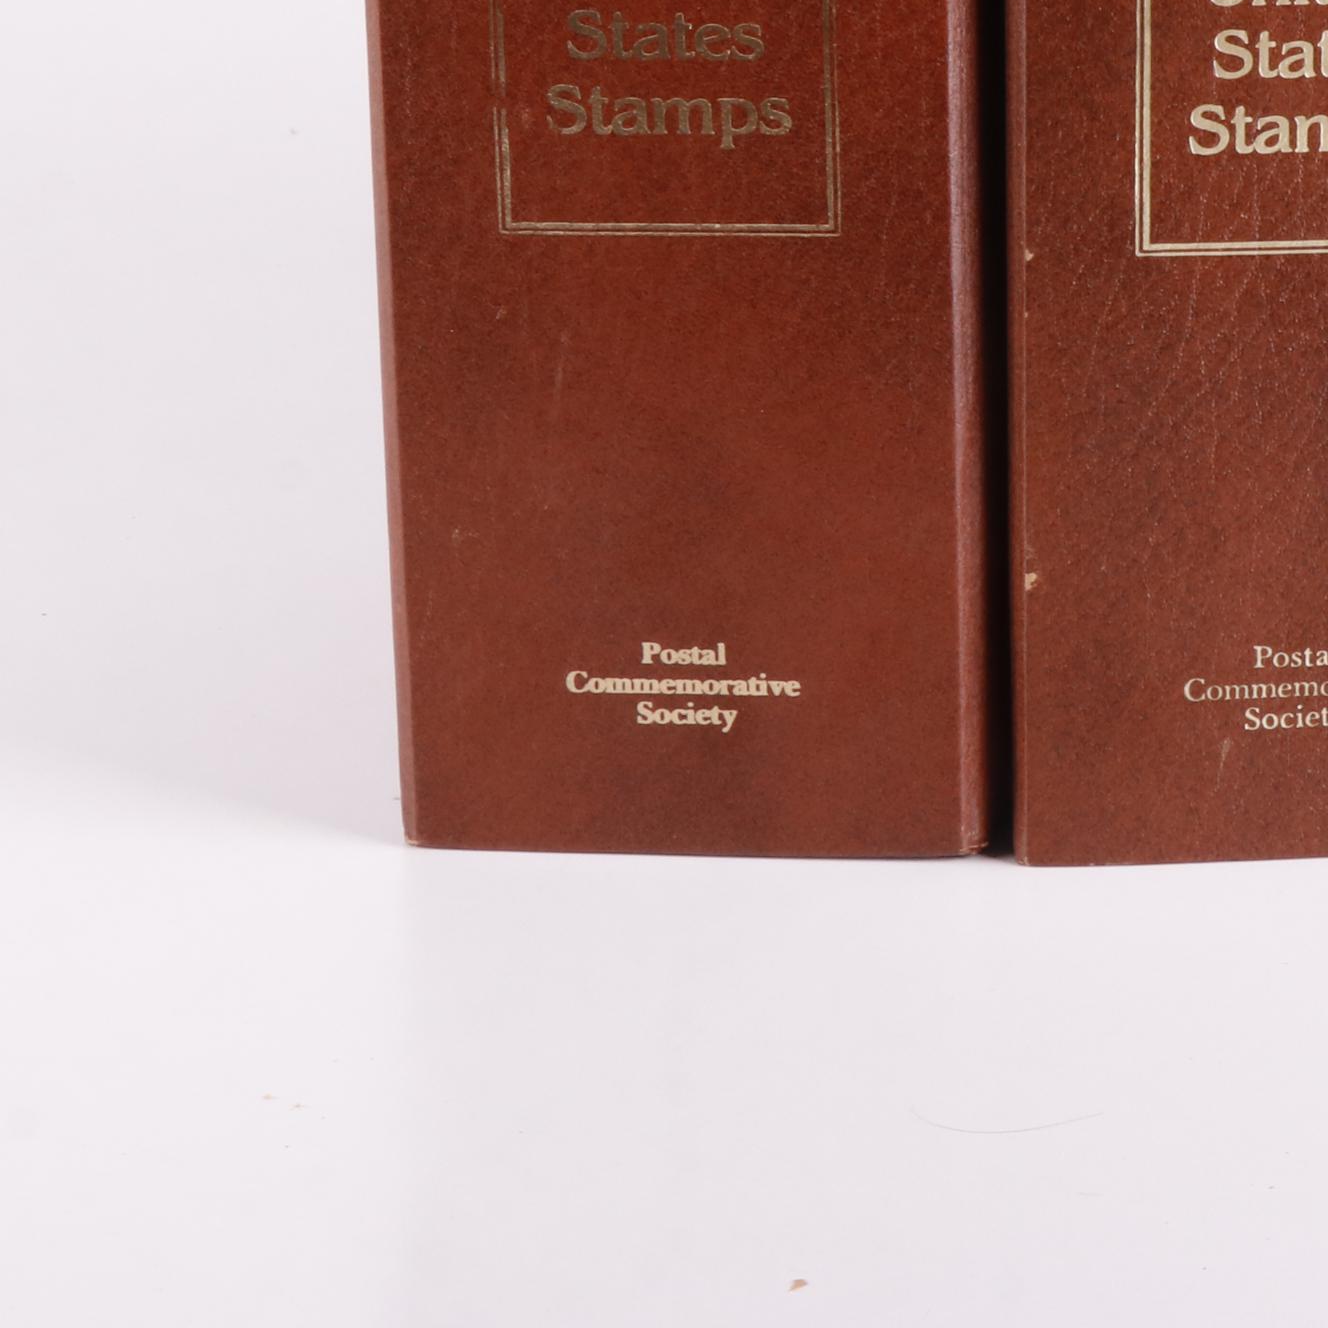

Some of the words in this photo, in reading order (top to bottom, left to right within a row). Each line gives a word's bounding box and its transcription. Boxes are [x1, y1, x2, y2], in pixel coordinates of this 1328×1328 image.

[567, 10, 764, 61] States
[546, 84, 792, 149] Stamps
[641, 642, 726, 665] Postal
[565, 670, 801, 697] Commemorative
[636, 701, 738, 733] Society
